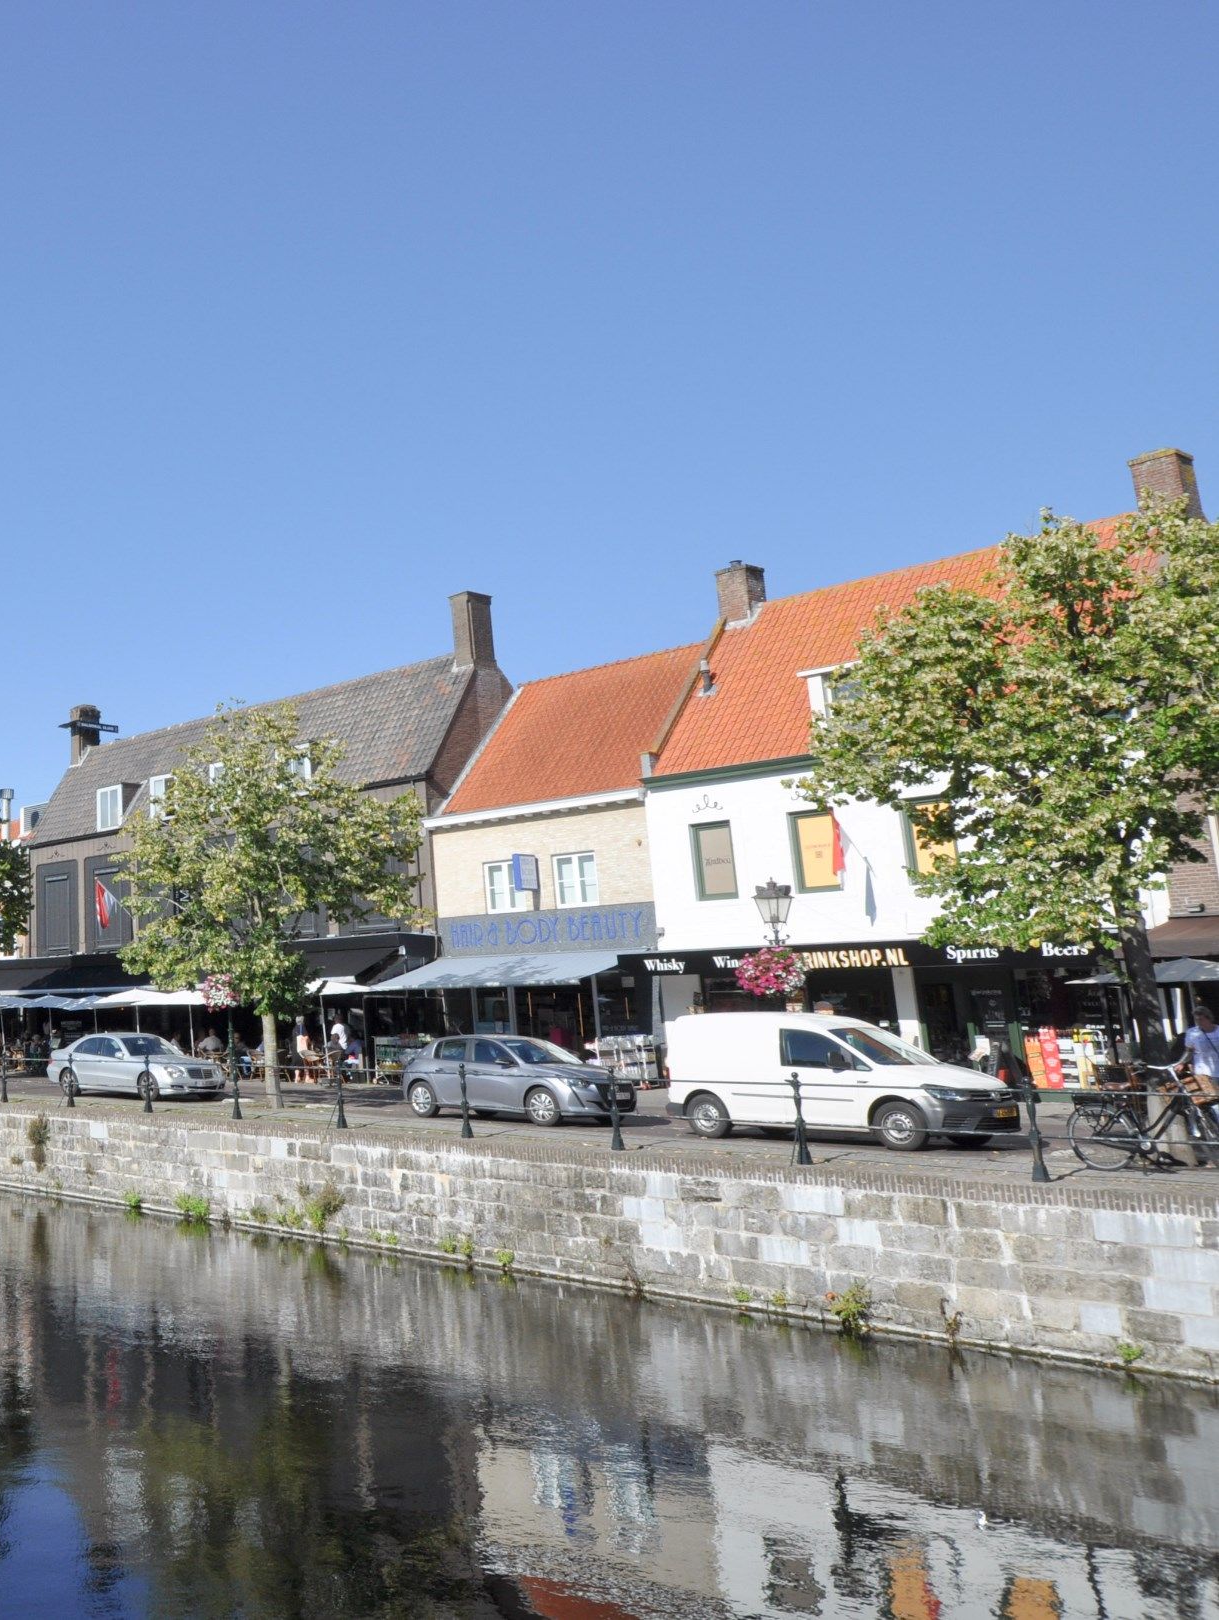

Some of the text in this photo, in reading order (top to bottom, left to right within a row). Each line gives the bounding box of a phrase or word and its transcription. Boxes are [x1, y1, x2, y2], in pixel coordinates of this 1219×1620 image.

[450, 922, 483, 949] HAIR
[505, 915, 560, 945] BODY
[566, 910, 643, 942] BEAUTY
[946, 944, 999, 964] Spirits
[1041, 941, 1089, 957] Beers
[643, 958, 686, 974] Whisky
[712, 955, 740, 969] Win
[802, 948, 909, 969] RINKSHOP.NL
